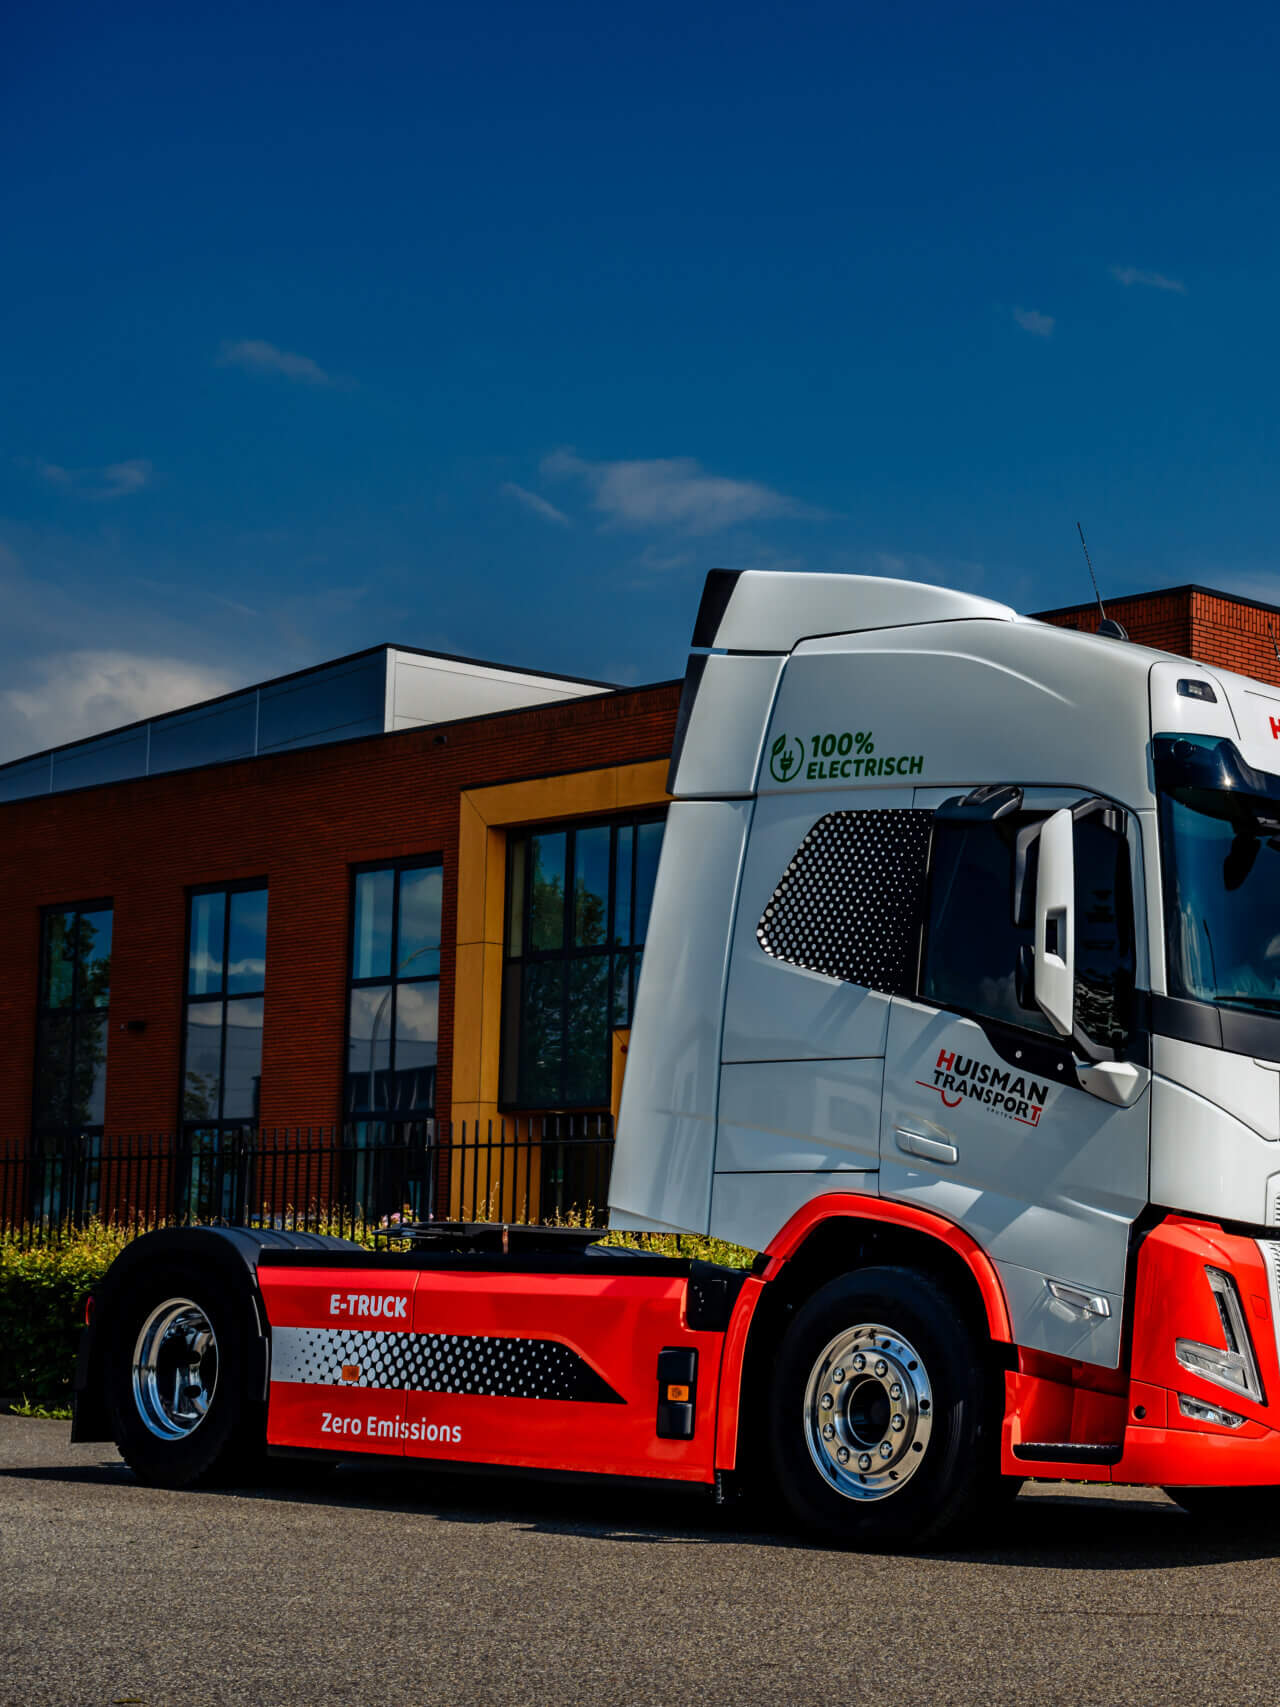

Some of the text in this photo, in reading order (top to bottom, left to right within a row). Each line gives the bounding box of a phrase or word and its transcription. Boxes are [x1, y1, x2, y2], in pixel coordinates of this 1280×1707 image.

[811, 731, 875, 758] 100%
[806, 755, 924, 780] ELECTRISCH
[936, 1048, 1049, 1105] HUISMAN
[933, 1069, 1042, 1121] TRANSPORT
[330, 1294, 408, 1318] E-TRUCK
[321, 1412, 462, 1443] Zero Emissions
